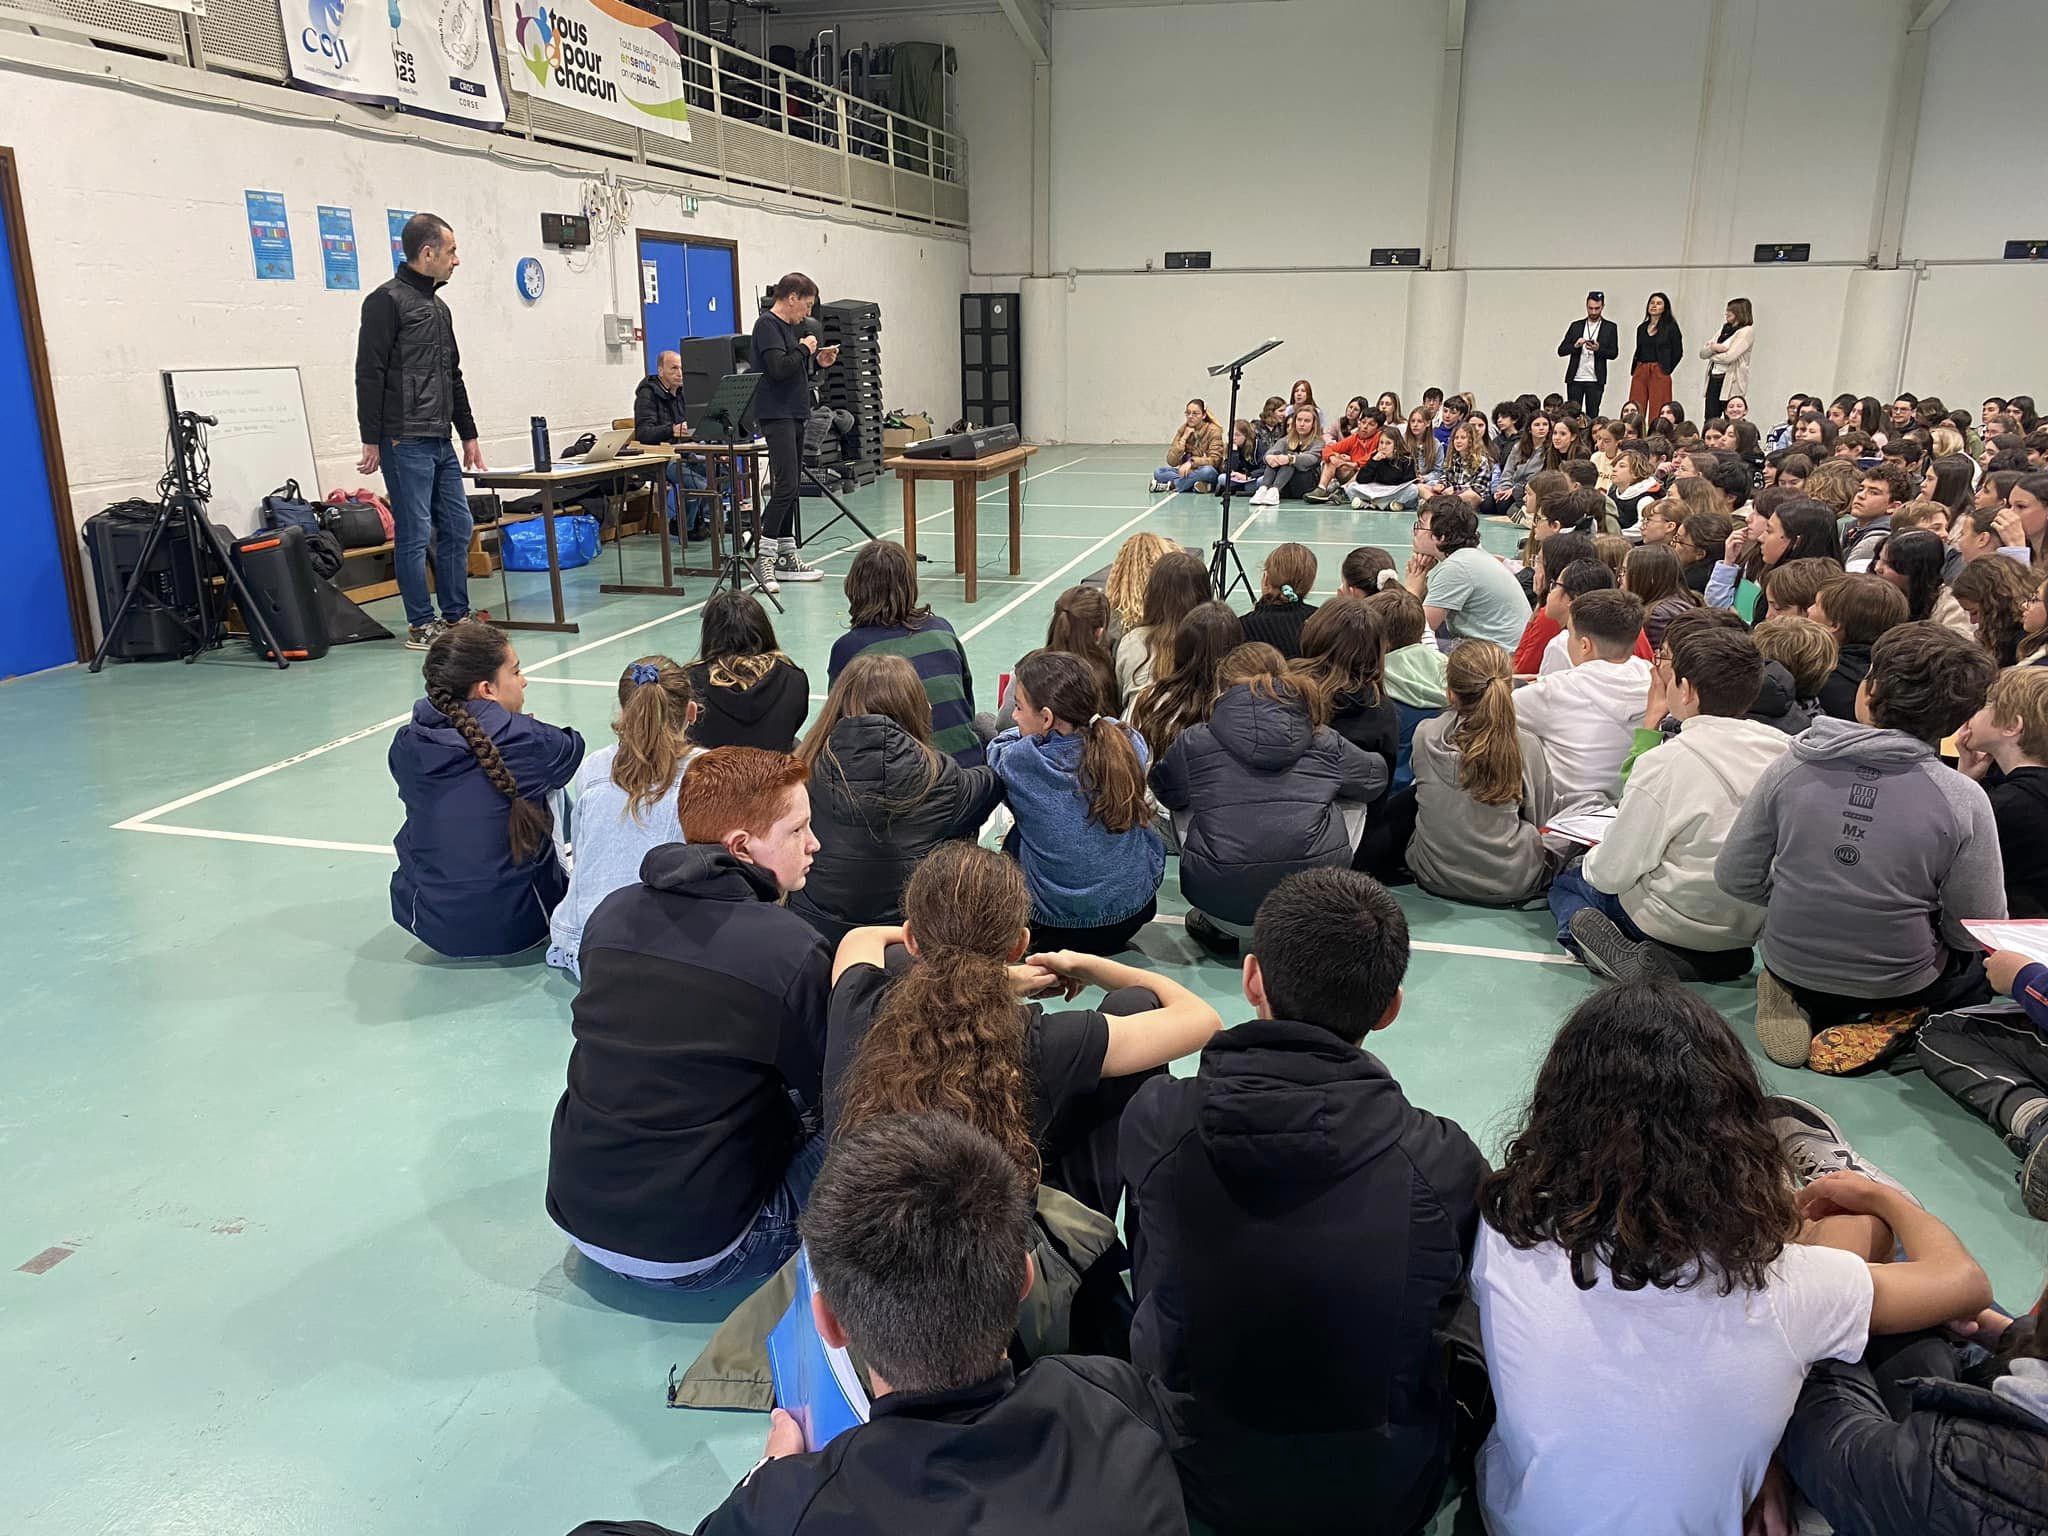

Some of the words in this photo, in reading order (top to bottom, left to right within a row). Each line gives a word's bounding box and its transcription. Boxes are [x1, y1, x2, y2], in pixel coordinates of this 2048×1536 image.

[548, 7, 589, 46] tous
[562, 42, 602, 75] pour
[620, 52, 658, 76] ensemble
[554, 67, 619, 103] chacun
[458, 97, 480, 109] CORSE
[1842, 823, 1867, 840] Mx
